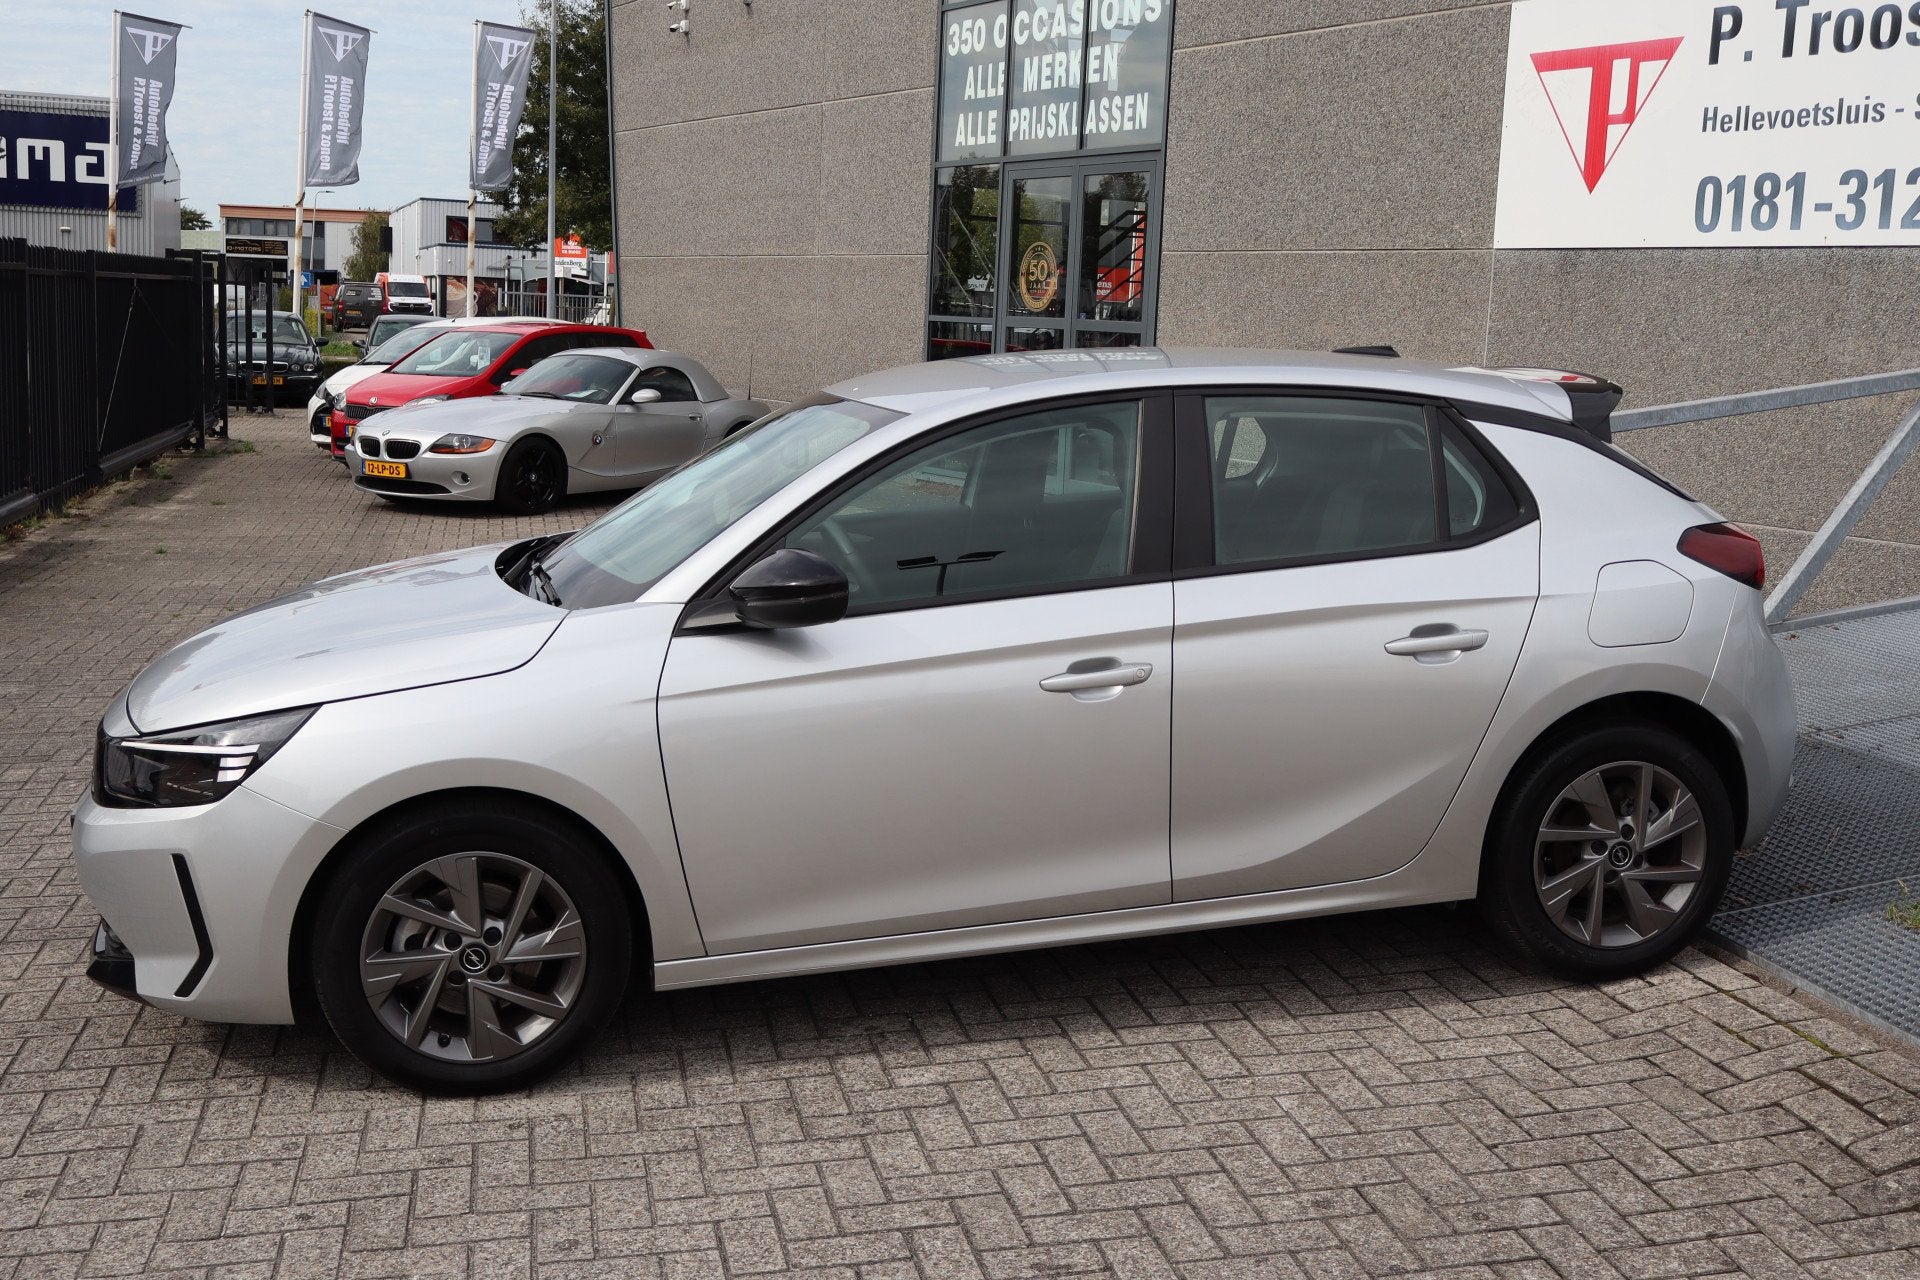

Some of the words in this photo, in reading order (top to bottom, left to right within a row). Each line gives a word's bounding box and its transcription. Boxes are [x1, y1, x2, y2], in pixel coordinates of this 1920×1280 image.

[948, 18, 986, 57] 350
[993, 0, 1162, 49] OCCASIONS
[1708, 5, 1753, 65] P.
[964, 61, 1005, 100] ALLE
[1022, 43, 1119, 93] MERKEN
[133, 126, 142, 135] &
[146, 78, 163, 147] Autobedrijf
[321, 123, 333, 133] &
[336, 76, 354, 146] Autobedrijf
[493, 83, 515, 151] Autobedrijf
[954, 109, 998, 147] ALLE
[1008, 92, 1149, 142] PRIJSKLASSEN
[1701, 95, 1886, 133] Hellevoetsluis
[319, 134, 332, 171] zonen
[481, 129, 492, 139] &
[0, 136, 110, 185] ma
[476, 140, 491, 175] zonen
[1029, 260, 1048, 281] 50
[367, 462, 401, 476] 12-LP-DS
